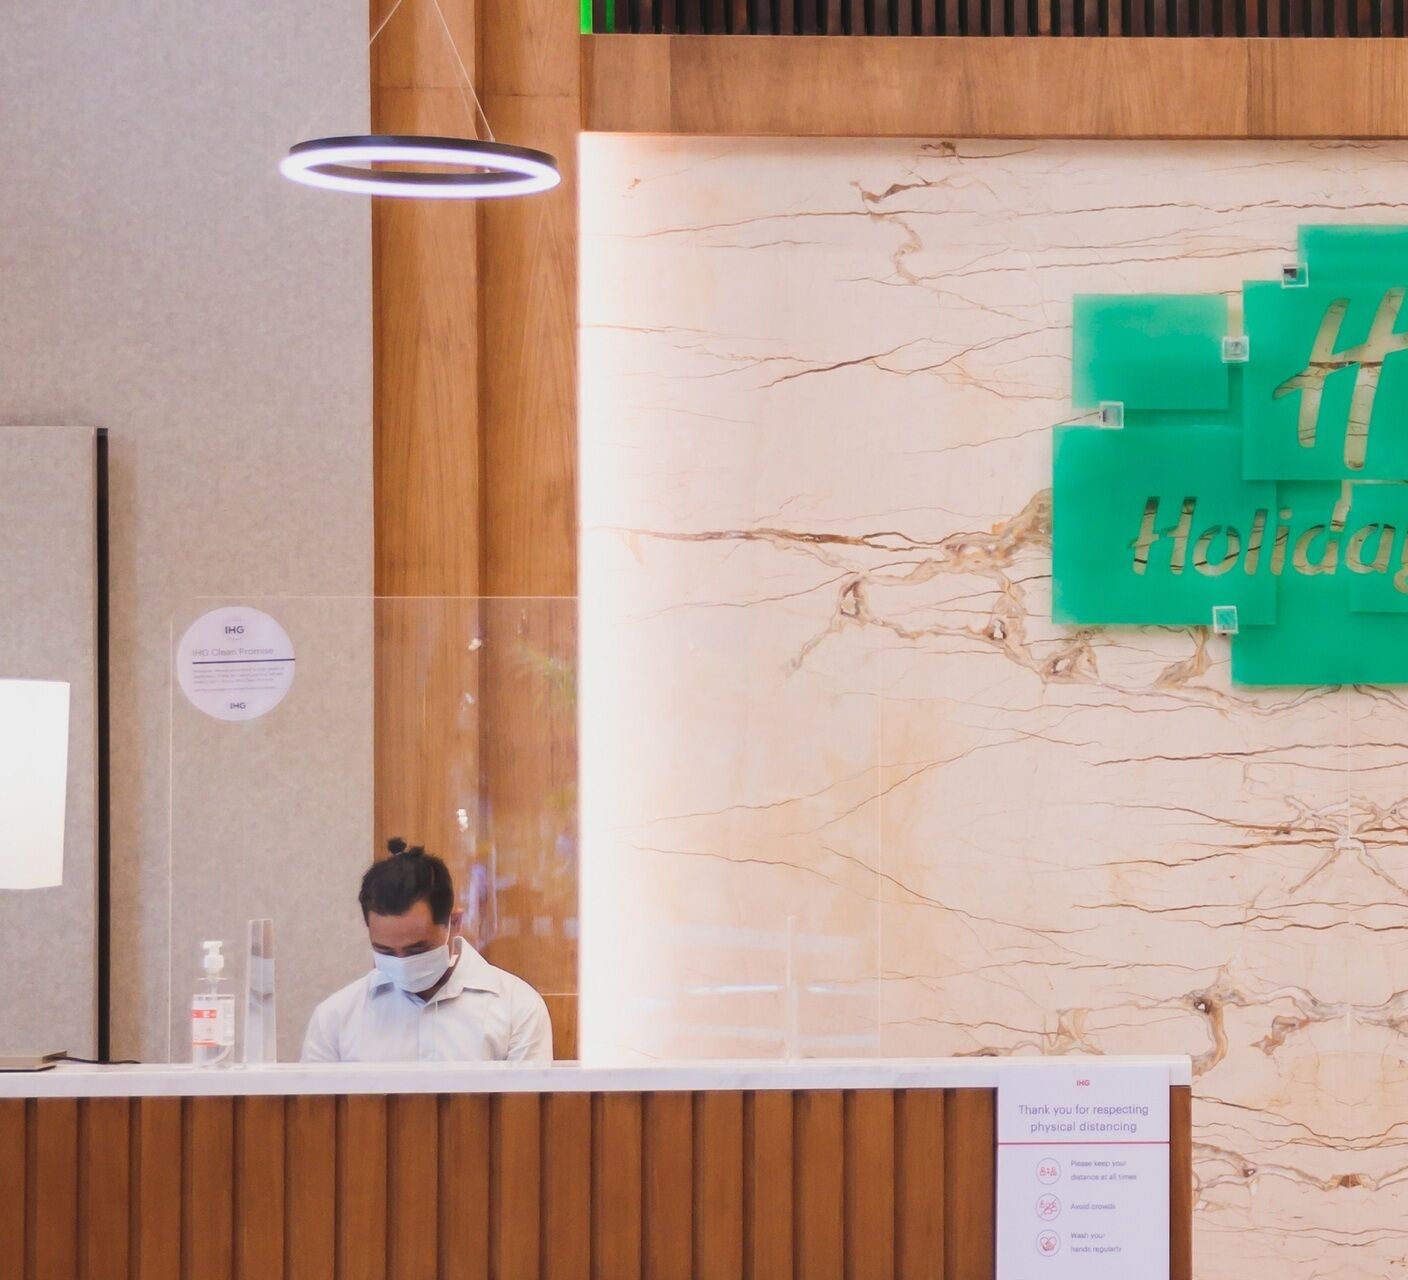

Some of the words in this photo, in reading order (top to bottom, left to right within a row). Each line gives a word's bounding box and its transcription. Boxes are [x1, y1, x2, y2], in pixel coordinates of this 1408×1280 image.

[224, 625, 245, 635] IHG
[192, 649, 209, 657] IHG
[211, 648, 237, 657] Clean
[239, 647, 274, 656] Promise
[230, 701, 247, 710] IHG
[1076, 1079, 1090, 1087] IHG
[1019, 1104, 1050, 1115] Thank
[1053, 1107, 1072, 1118] you
[1075, 1104, 1089, 1115] for
[1093, 1104, 1149, 1116] respecting
[1030, 1121, 1076, 1133] physical
[1079, 1121, 1137, 1133] distancing
[1094, 1160, 1110, 1168] keep
